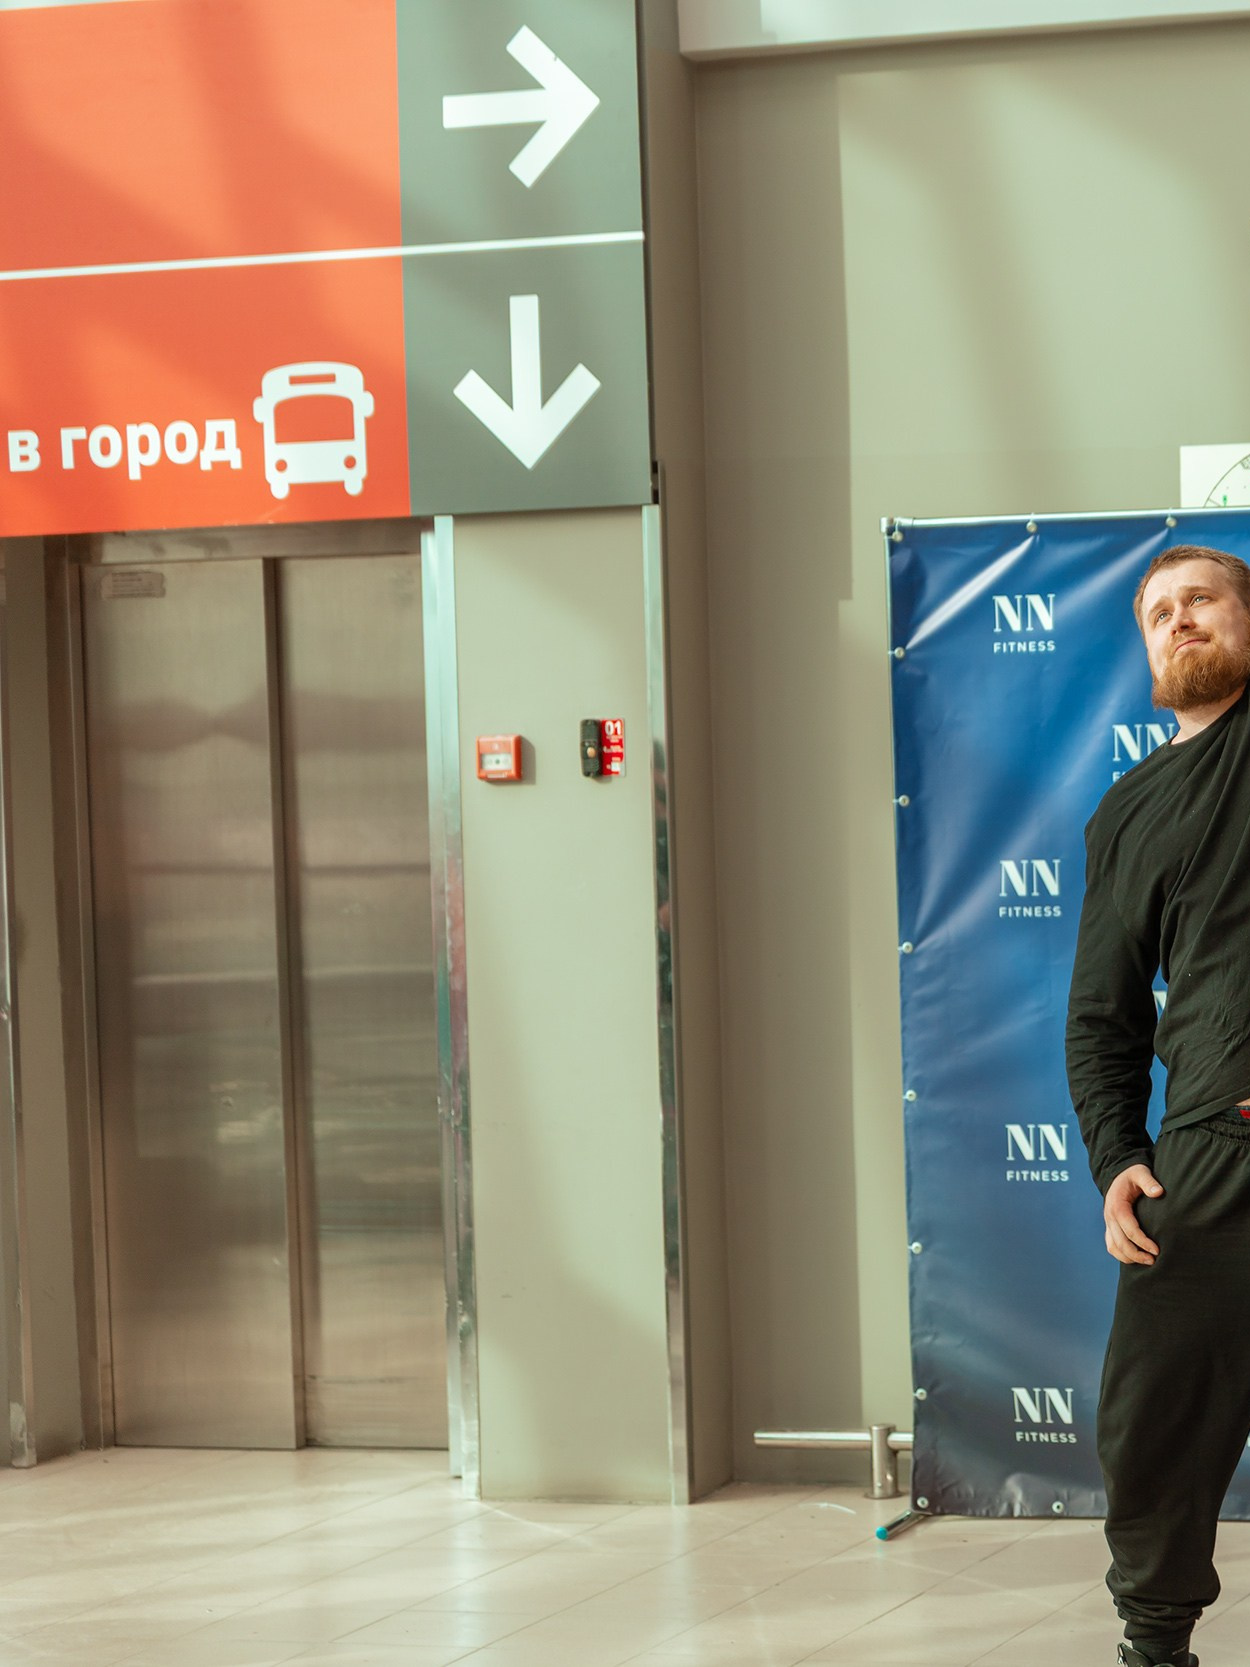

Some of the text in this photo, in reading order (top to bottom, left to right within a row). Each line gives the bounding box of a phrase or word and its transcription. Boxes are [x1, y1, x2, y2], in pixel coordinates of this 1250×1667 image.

[7, 418, 243, 481] в город
[993, 593, 1055, 633] NN
[993, 640, 1056, 654] FITNESS
[604, 720, 622, 736] 01
[999, 859, 1060, 897] NN
[998, 905, 1062, 918] FITNESS
[1005, 1123, 1068, 1161] NN
[1006, 1170, 1069, 1182] FITNESS
[1011, 1387, 1074, 1425] NN
[1015, 1431, 1077, 1444] FITNESS
